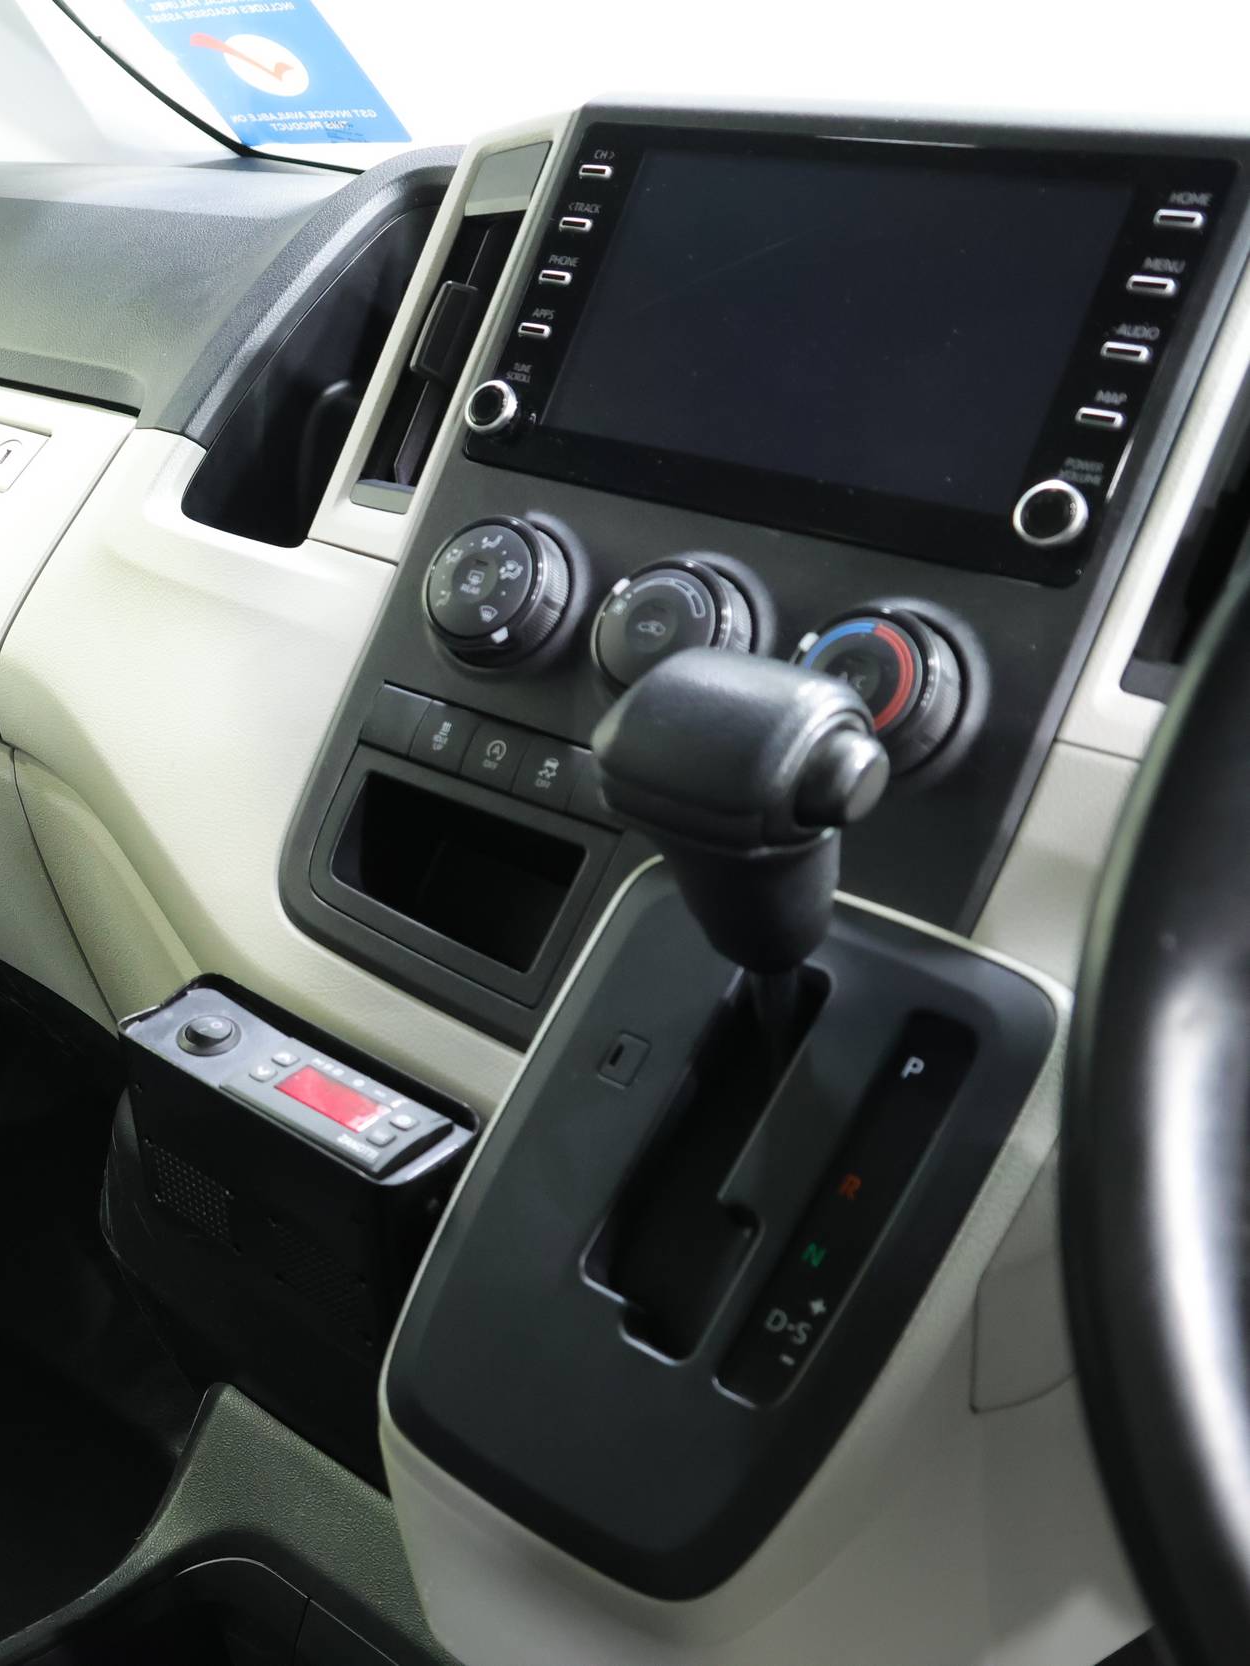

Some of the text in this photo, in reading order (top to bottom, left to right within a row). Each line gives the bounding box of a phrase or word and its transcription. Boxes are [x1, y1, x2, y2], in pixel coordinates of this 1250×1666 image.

[1170, 191, 1213, 206] HOME
[548, 254, 580, 267] PHONE
[1144, 257, 1186, 274] MENU
[532, 308, 555, 320] APPS
[1115, 323, 1161, 341] AUDIO
[1096, 390, 1128, 405] MAP
[901, 1056, 925, 1079] P
[838, 1174, 862, 1199] R
[801, 1241, 827, 1268] N
